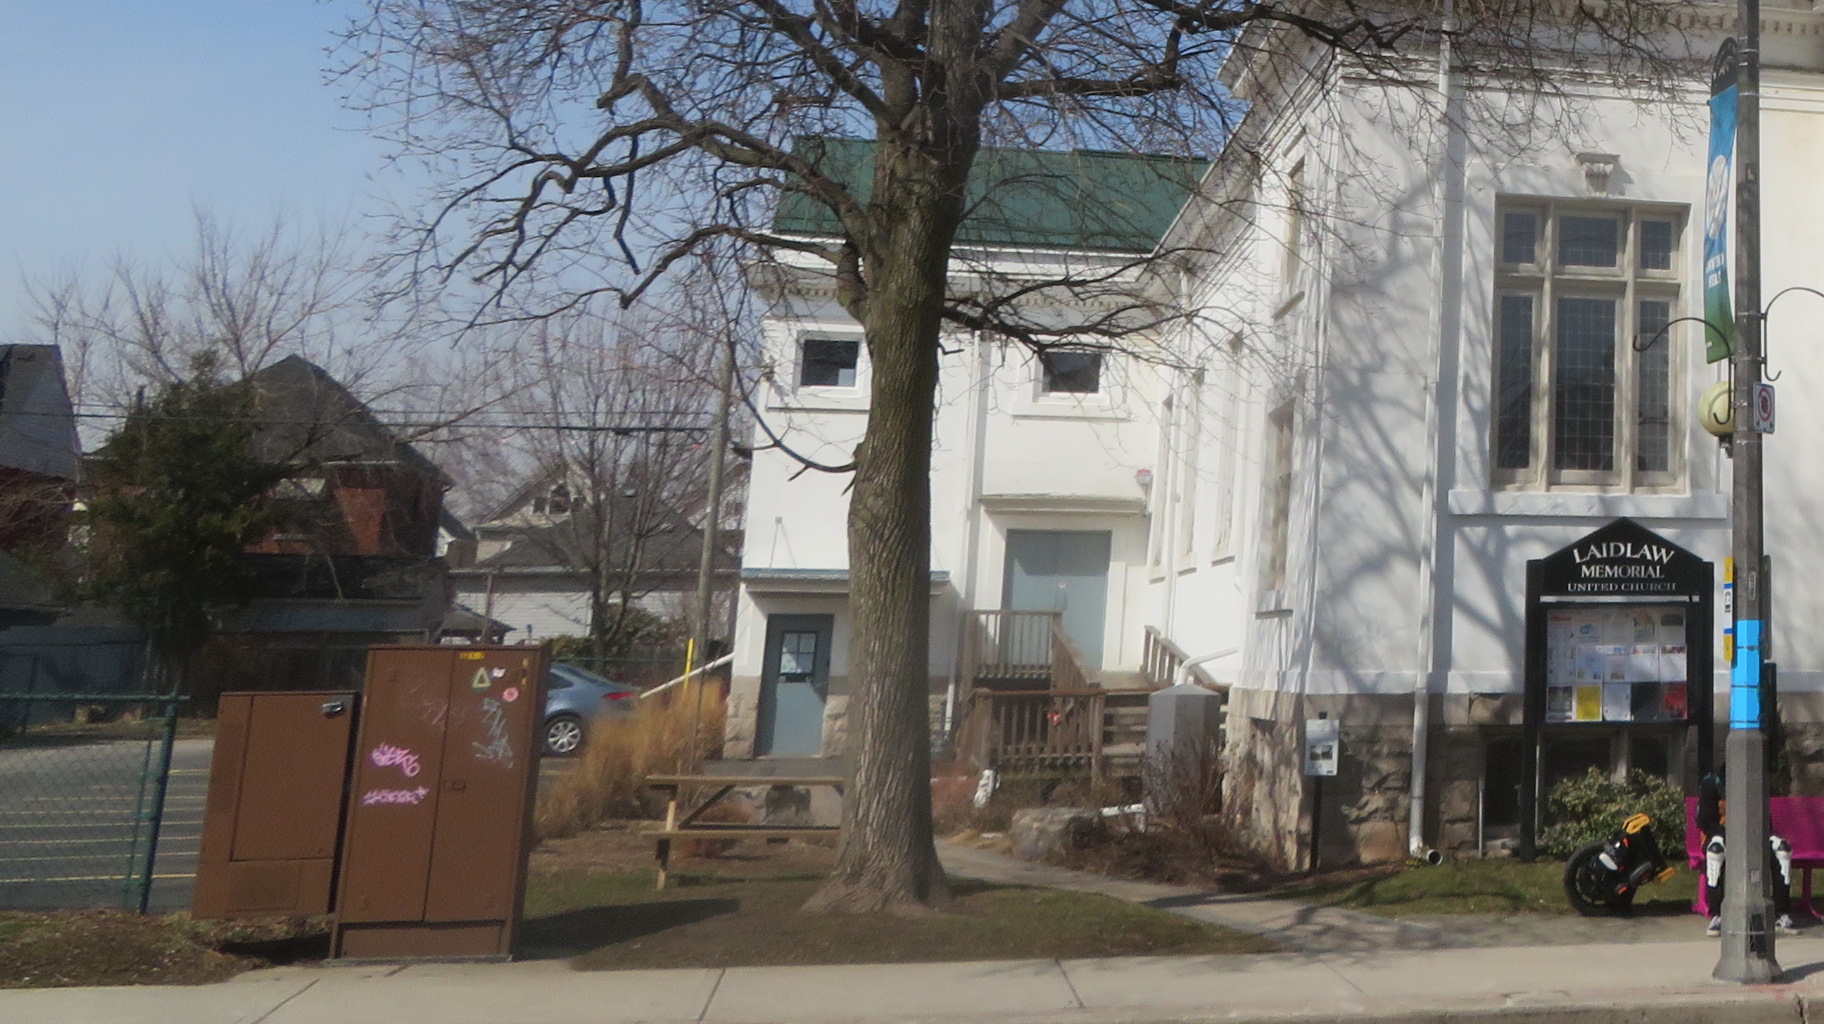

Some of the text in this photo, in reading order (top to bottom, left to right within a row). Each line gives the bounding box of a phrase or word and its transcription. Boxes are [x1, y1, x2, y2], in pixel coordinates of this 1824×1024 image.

[1573, 542, 1675, 564] LAIDLAW
[1581, 565, 1664, 578] MEMORIAL
[1568, 582, 1675, 592] UNITED CHURCH
